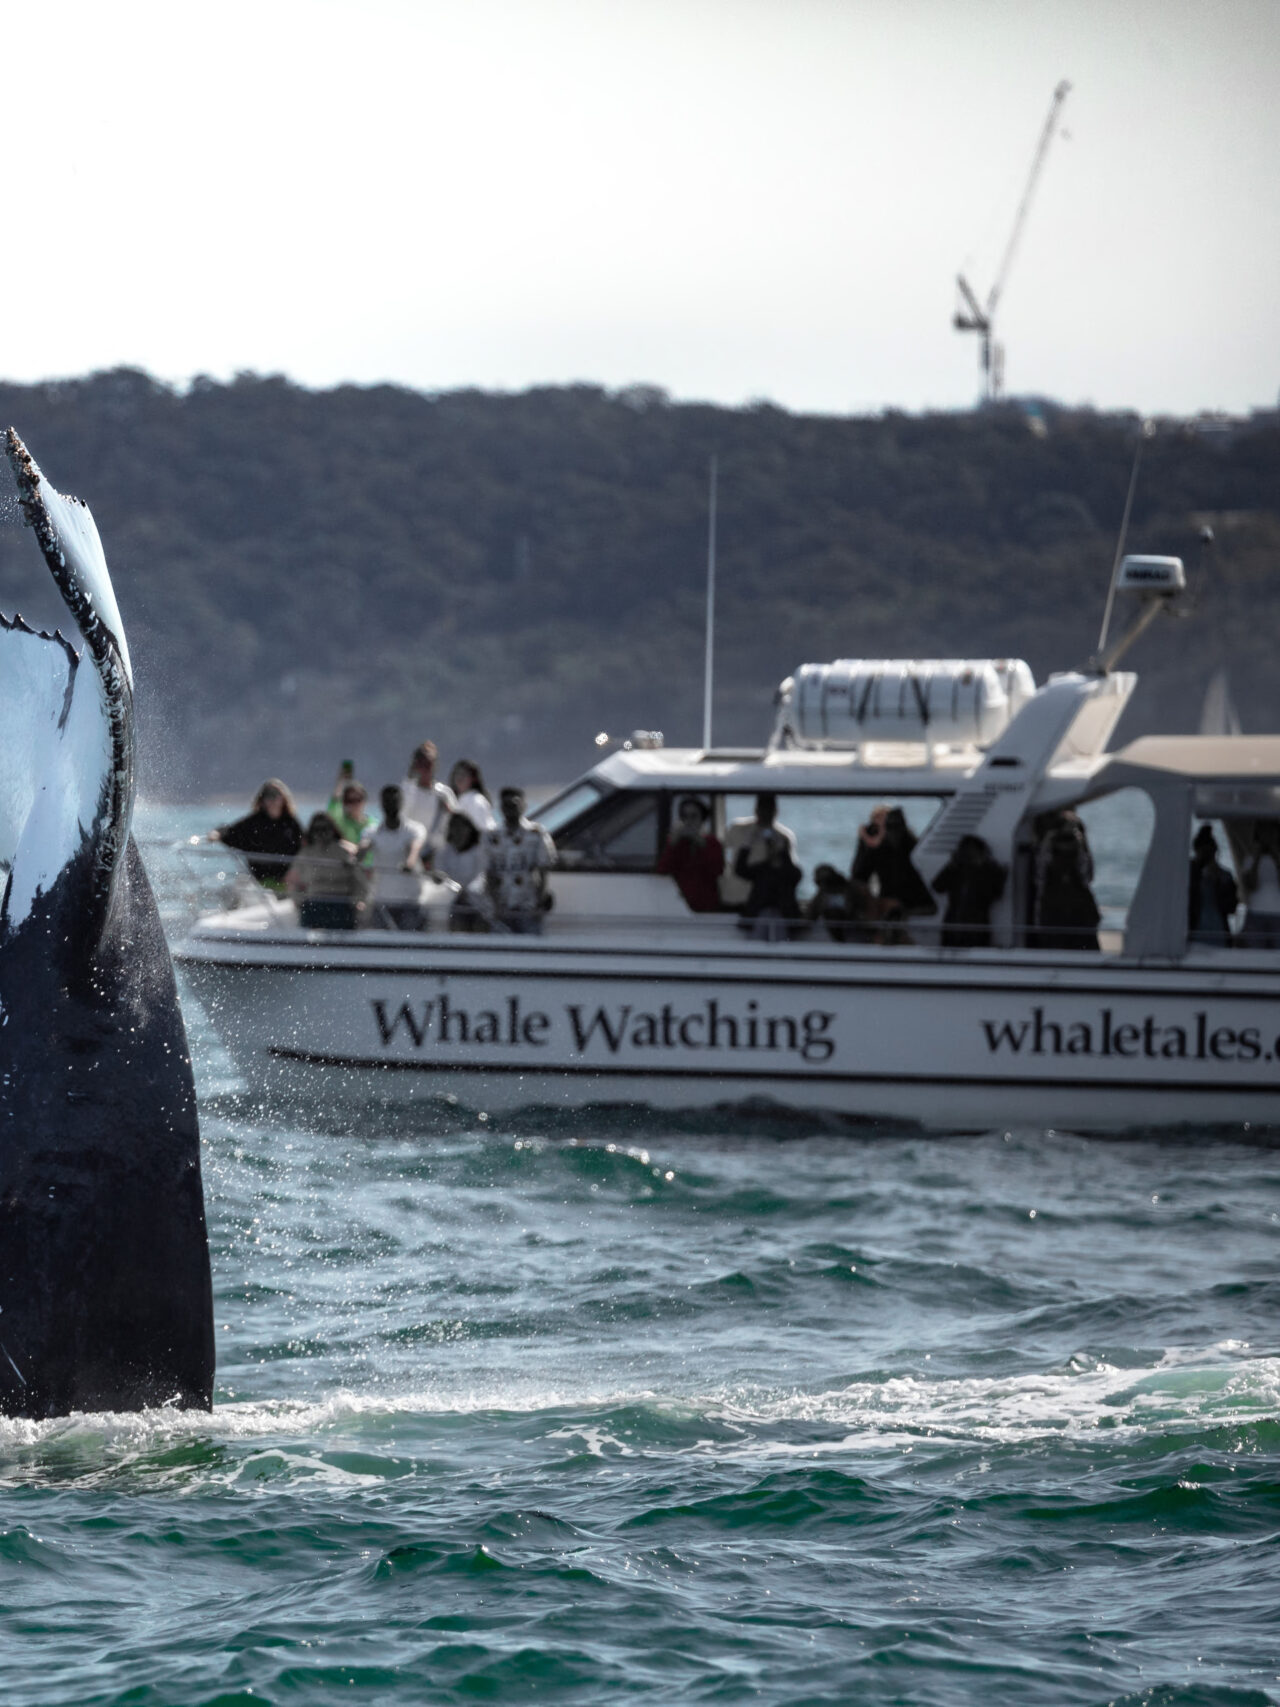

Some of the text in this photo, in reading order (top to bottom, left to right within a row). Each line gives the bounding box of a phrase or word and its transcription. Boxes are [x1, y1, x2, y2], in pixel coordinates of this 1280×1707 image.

[370, 994, 836, 1064] Whale Watching
[982, 1006, 1280, 1064] whaletales.
